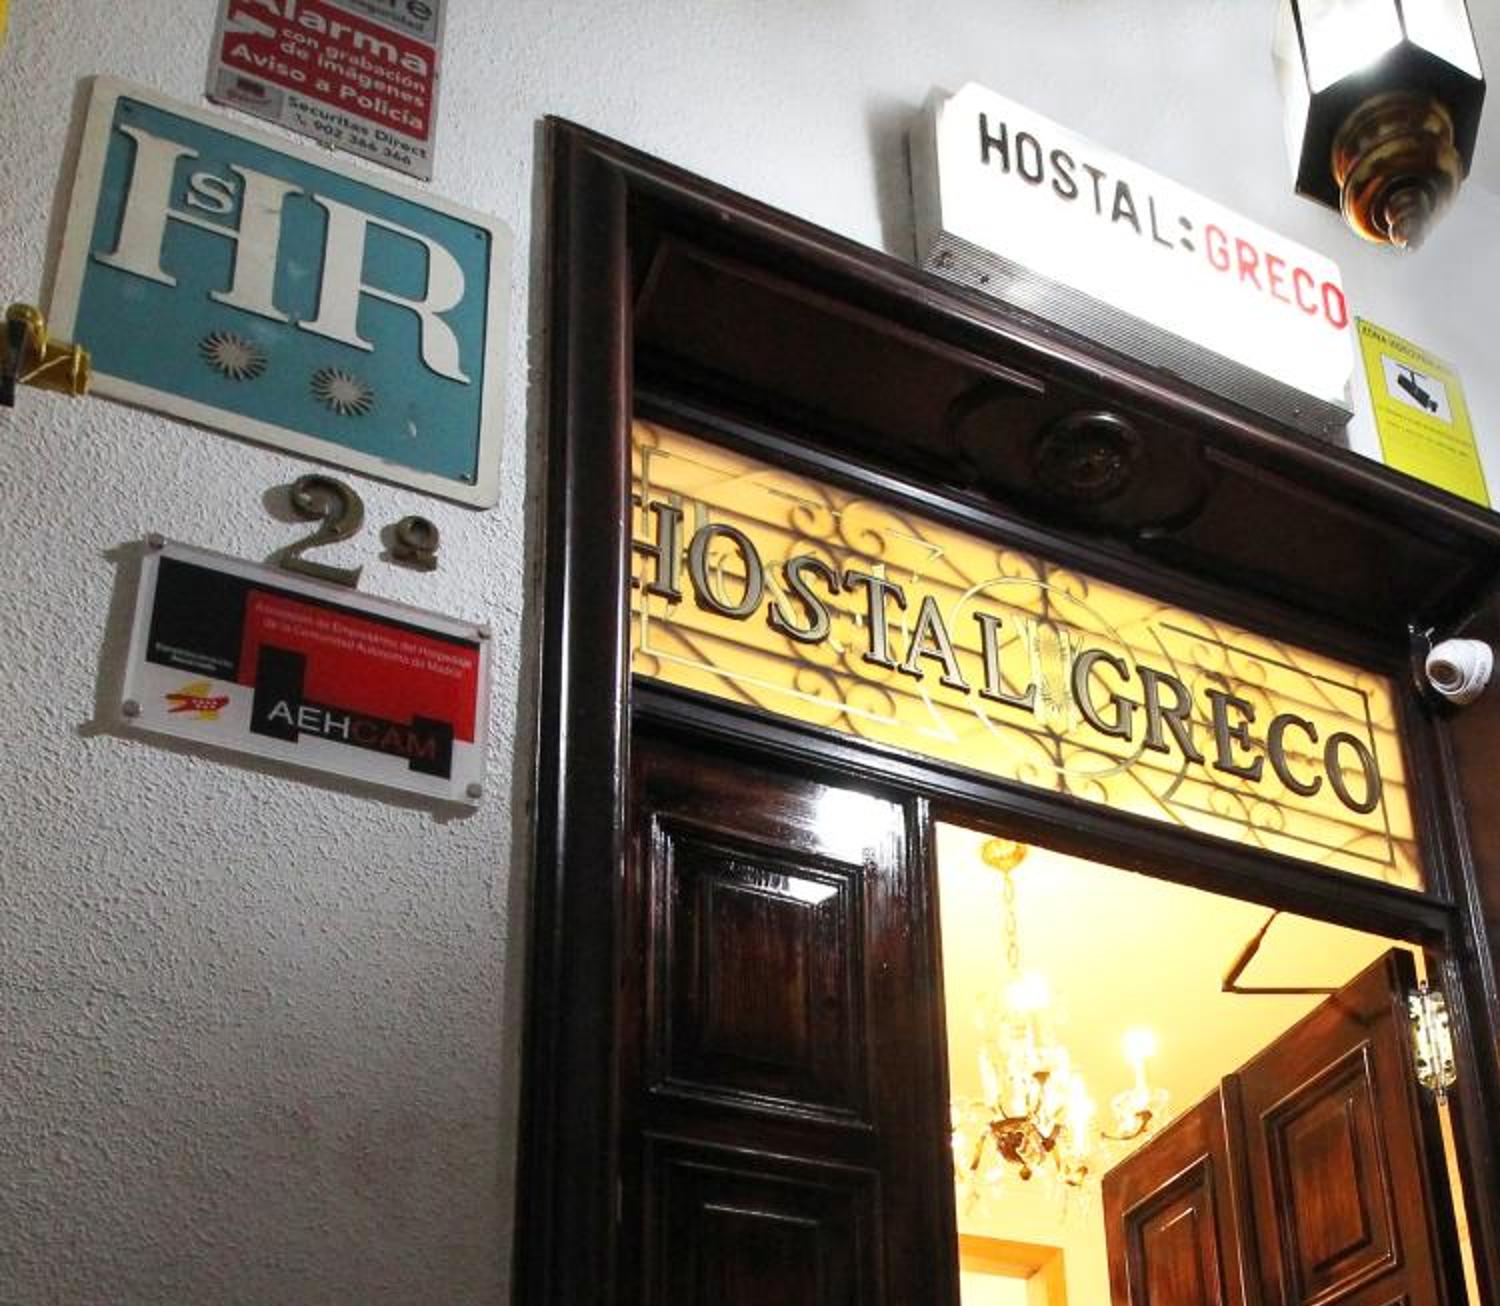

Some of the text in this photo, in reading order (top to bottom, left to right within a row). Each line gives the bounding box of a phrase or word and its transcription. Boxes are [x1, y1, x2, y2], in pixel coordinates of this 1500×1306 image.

[280, 41, 308, 60] de
[283, 28, 425, 93] con grabación
[231, 44, 424, 131] Aviso a Policía
[288, 96, 370, 136] Securitas
[374, 129, 427, 158] Direct
[1205, 224, 1349, 330] GRECO
[632, 497, 1383, 815] HOSTAL GRECO
[268, 700, 437, 760] AEHCAM
